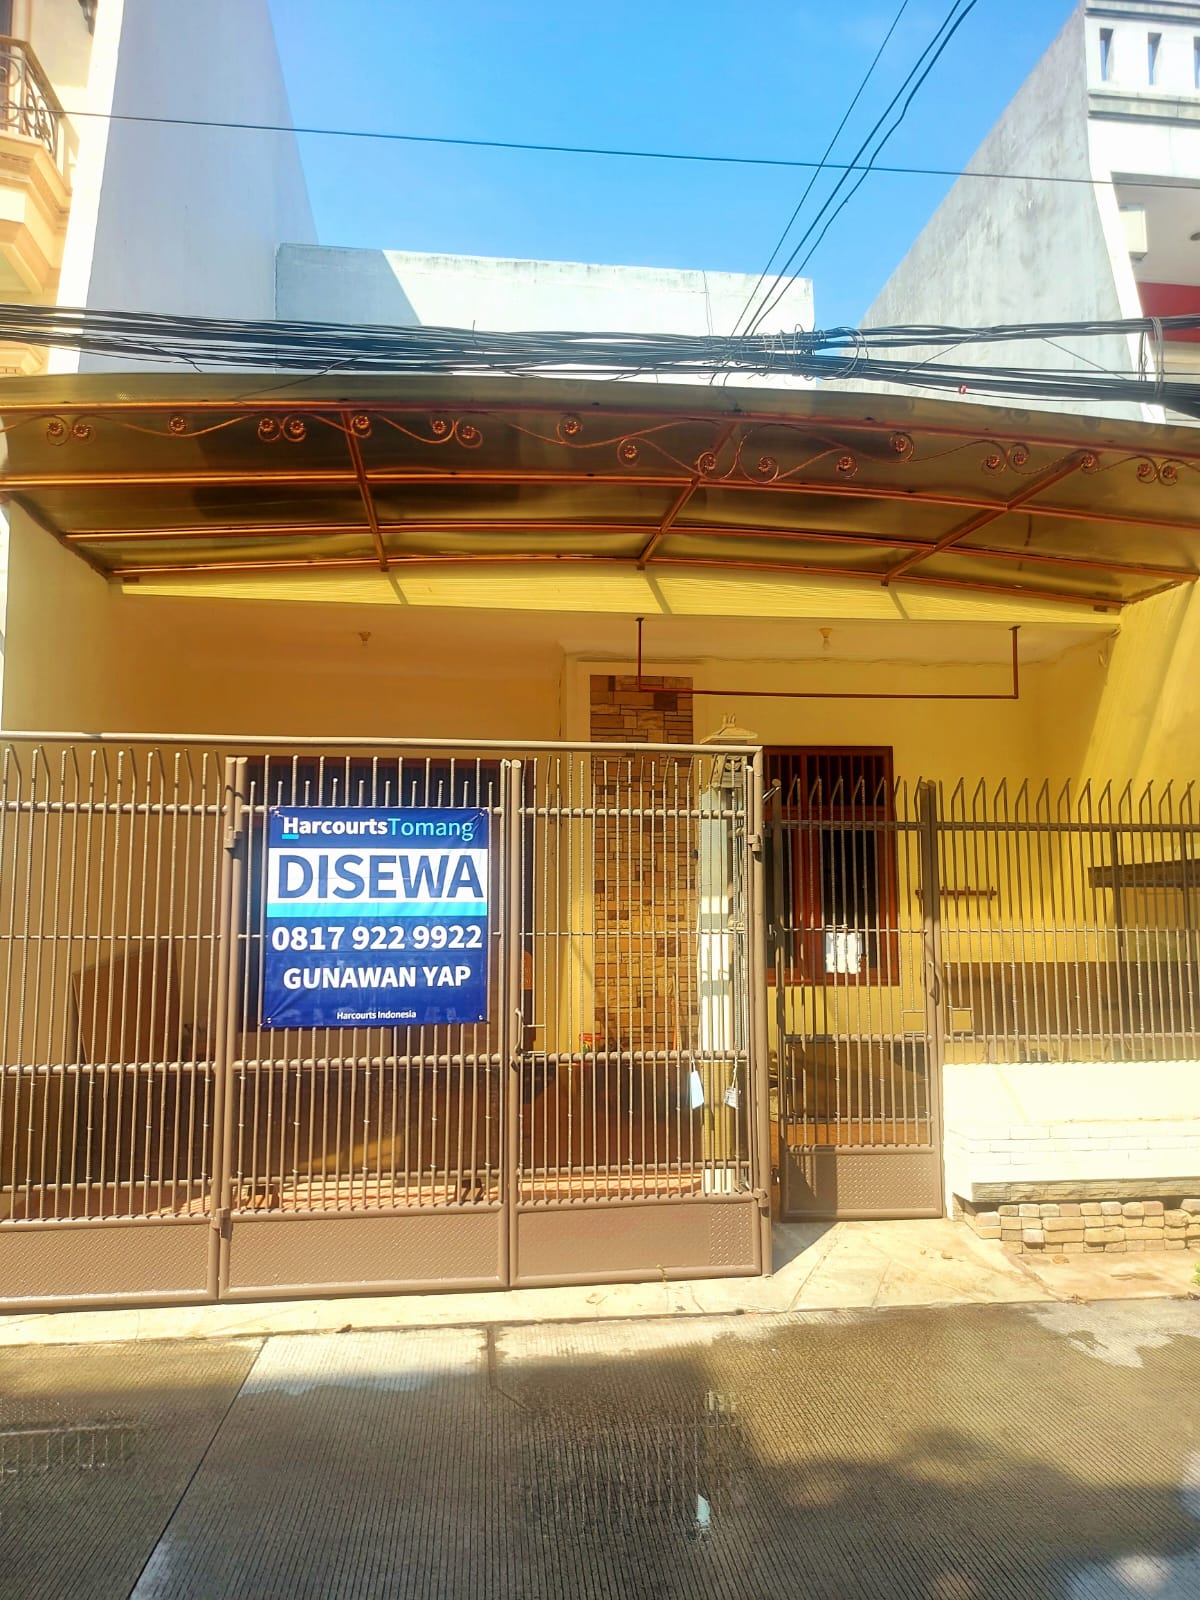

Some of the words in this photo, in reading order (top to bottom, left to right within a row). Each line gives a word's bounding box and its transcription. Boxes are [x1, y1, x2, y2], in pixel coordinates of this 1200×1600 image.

[278, 855, 484, 899] DISEWA
[272, 926, 345, 951] 0817
[352, 926, 405, 950] 922
[412, 924, 483, 949] 9922
[283, 966, 417, 990] GUNAWAN
[421, 965, 472, 987] YAP
[336, 1011, 377, 1020] Harcourts
[377, 1009, 417, 1019] Indonesia
